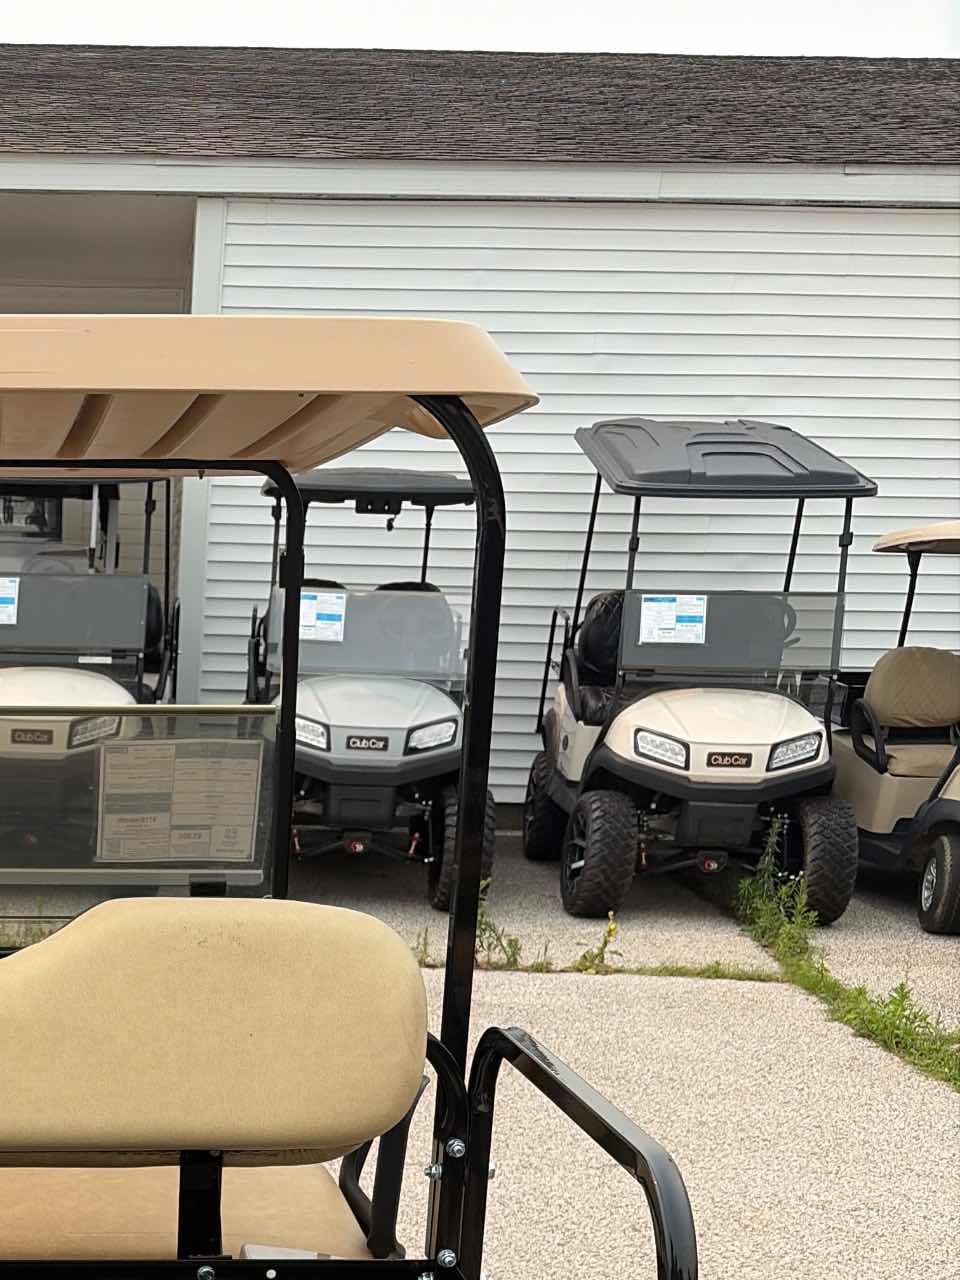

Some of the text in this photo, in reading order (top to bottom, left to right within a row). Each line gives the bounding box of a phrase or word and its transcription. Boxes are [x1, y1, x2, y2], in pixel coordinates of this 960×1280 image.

[15, 730, 34, 742] Club
[349, 738, 385, 748] Club Car
[711, 754, 748, 765] Club Car
